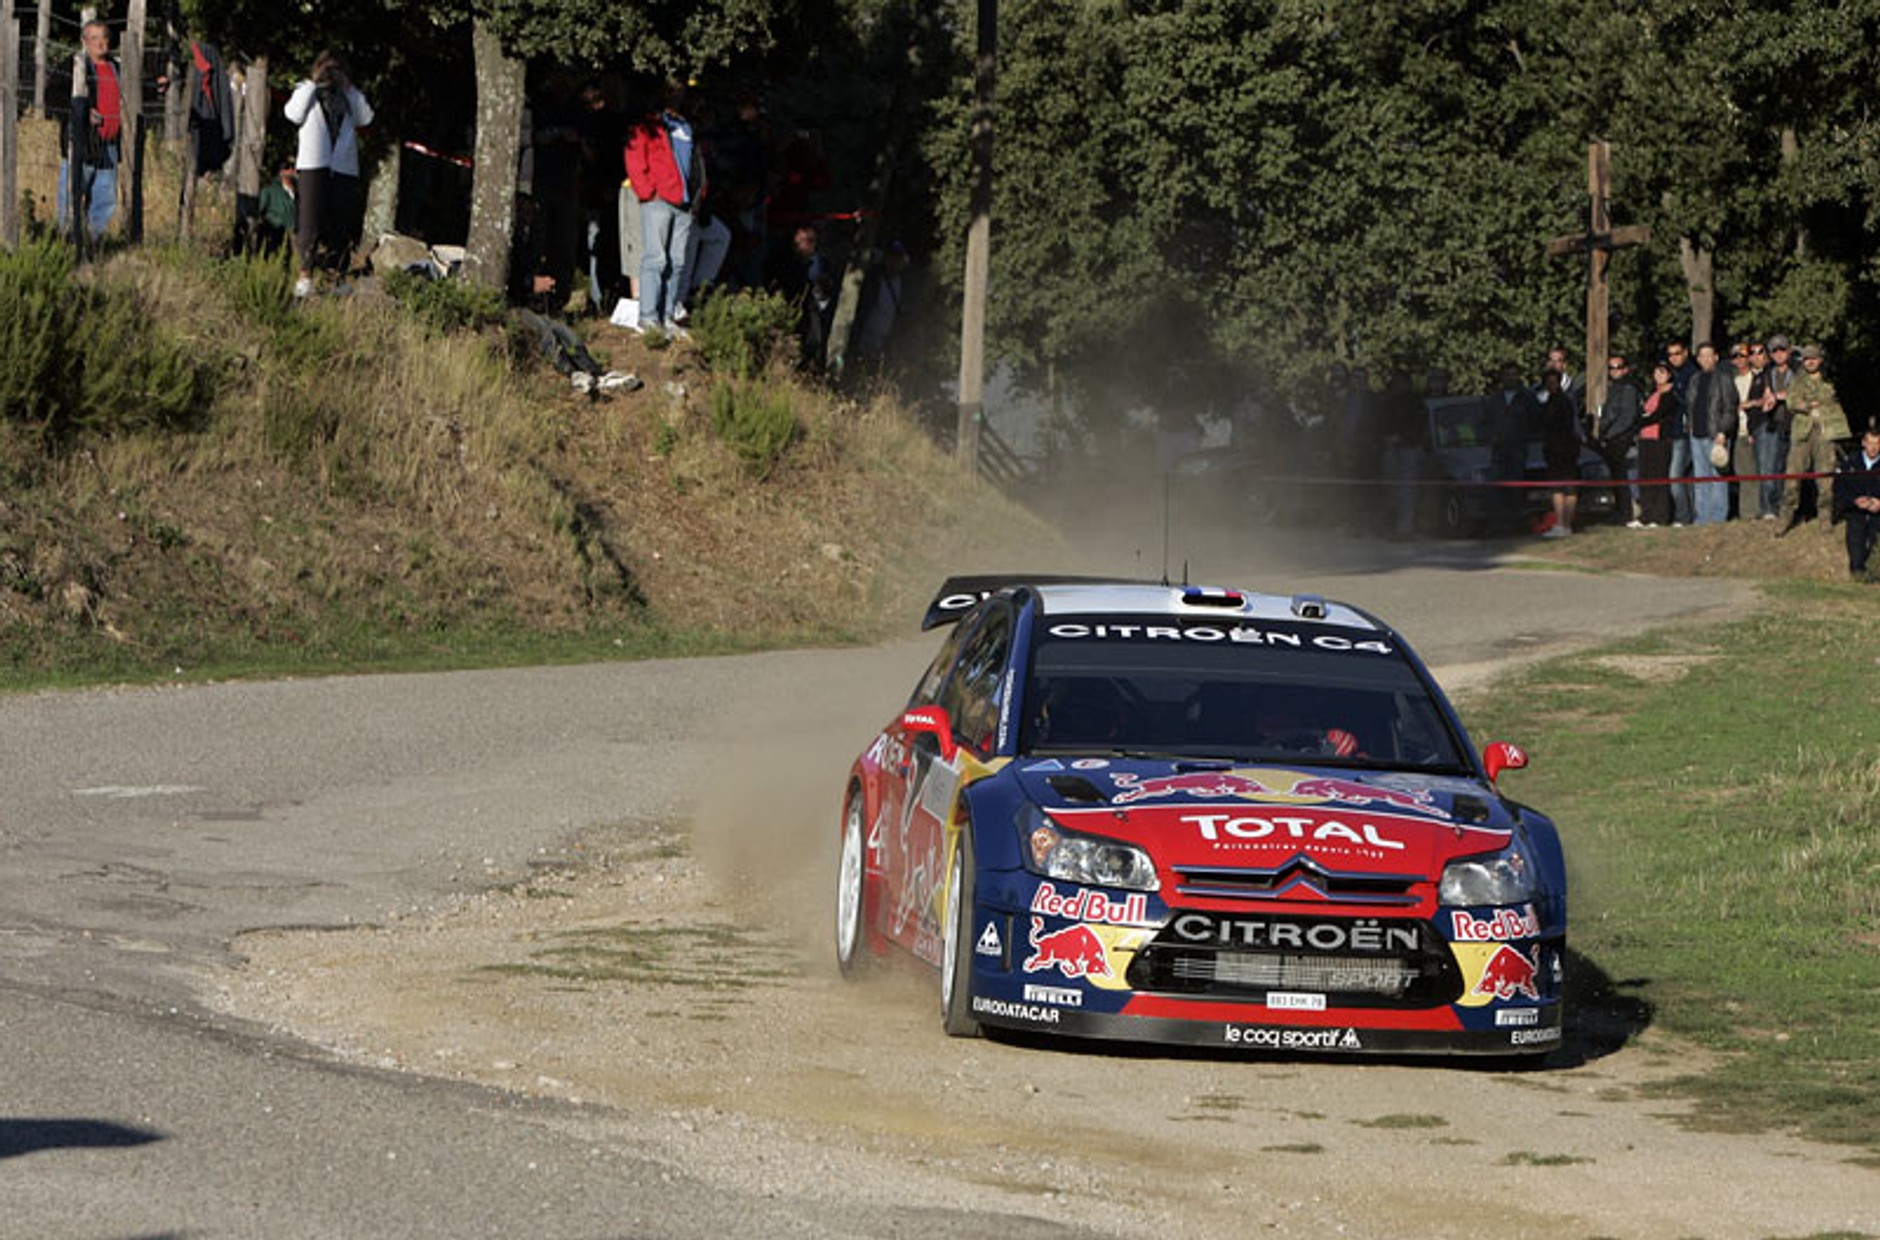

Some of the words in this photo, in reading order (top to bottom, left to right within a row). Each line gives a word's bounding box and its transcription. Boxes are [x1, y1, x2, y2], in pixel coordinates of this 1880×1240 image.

[1049, 622, 1301, 647] CITROËN
[1312, 635, 1393, 655] C4
[1180, 814, 1406, 850] TOTAL
[1030, 881, 1088, 920] Red
[1082, 892, 1148, 926] Bull
[1174, 915, 1419, 950] CITROËN
[1452, 908, 1510, 941] Red
[1327, 967, 1420, 989] SPORT
[973, 995, 1061, 1023] EURODATACAR
[1225, 1023, 1241, 1042] le
[1242, 1027, 1281, 1047] coq
[1281, 1029, 1342, 1049] sportif
